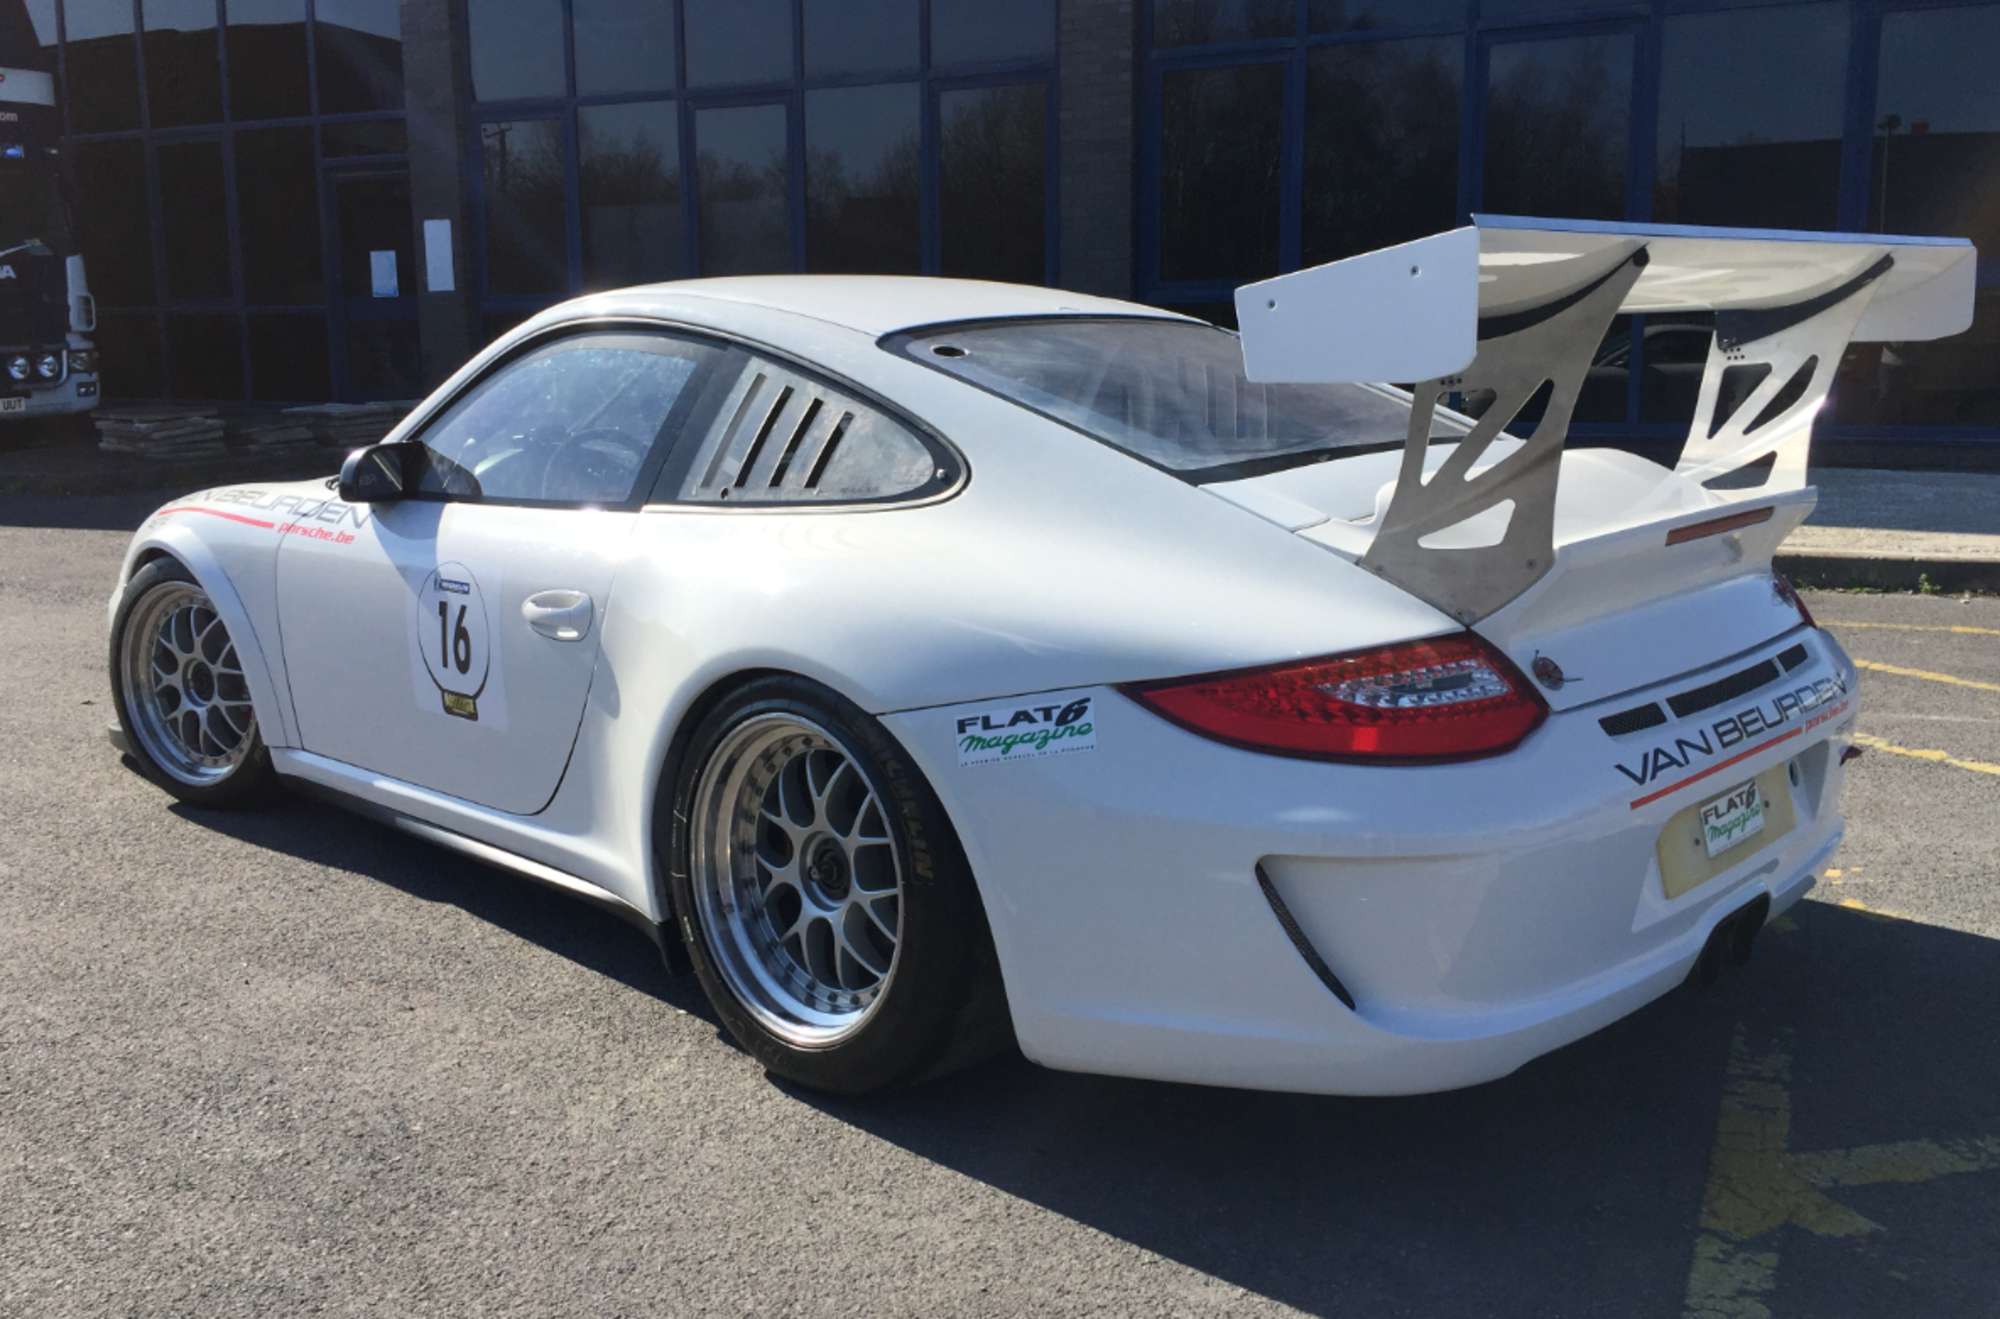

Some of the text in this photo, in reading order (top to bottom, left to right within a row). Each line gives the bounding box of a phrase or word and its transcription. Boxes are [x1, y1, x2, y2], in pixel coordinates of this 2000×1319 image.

[439, 601, 472, 675] 16
[1615, 671, 1848, 786] VAN BEURDEN
